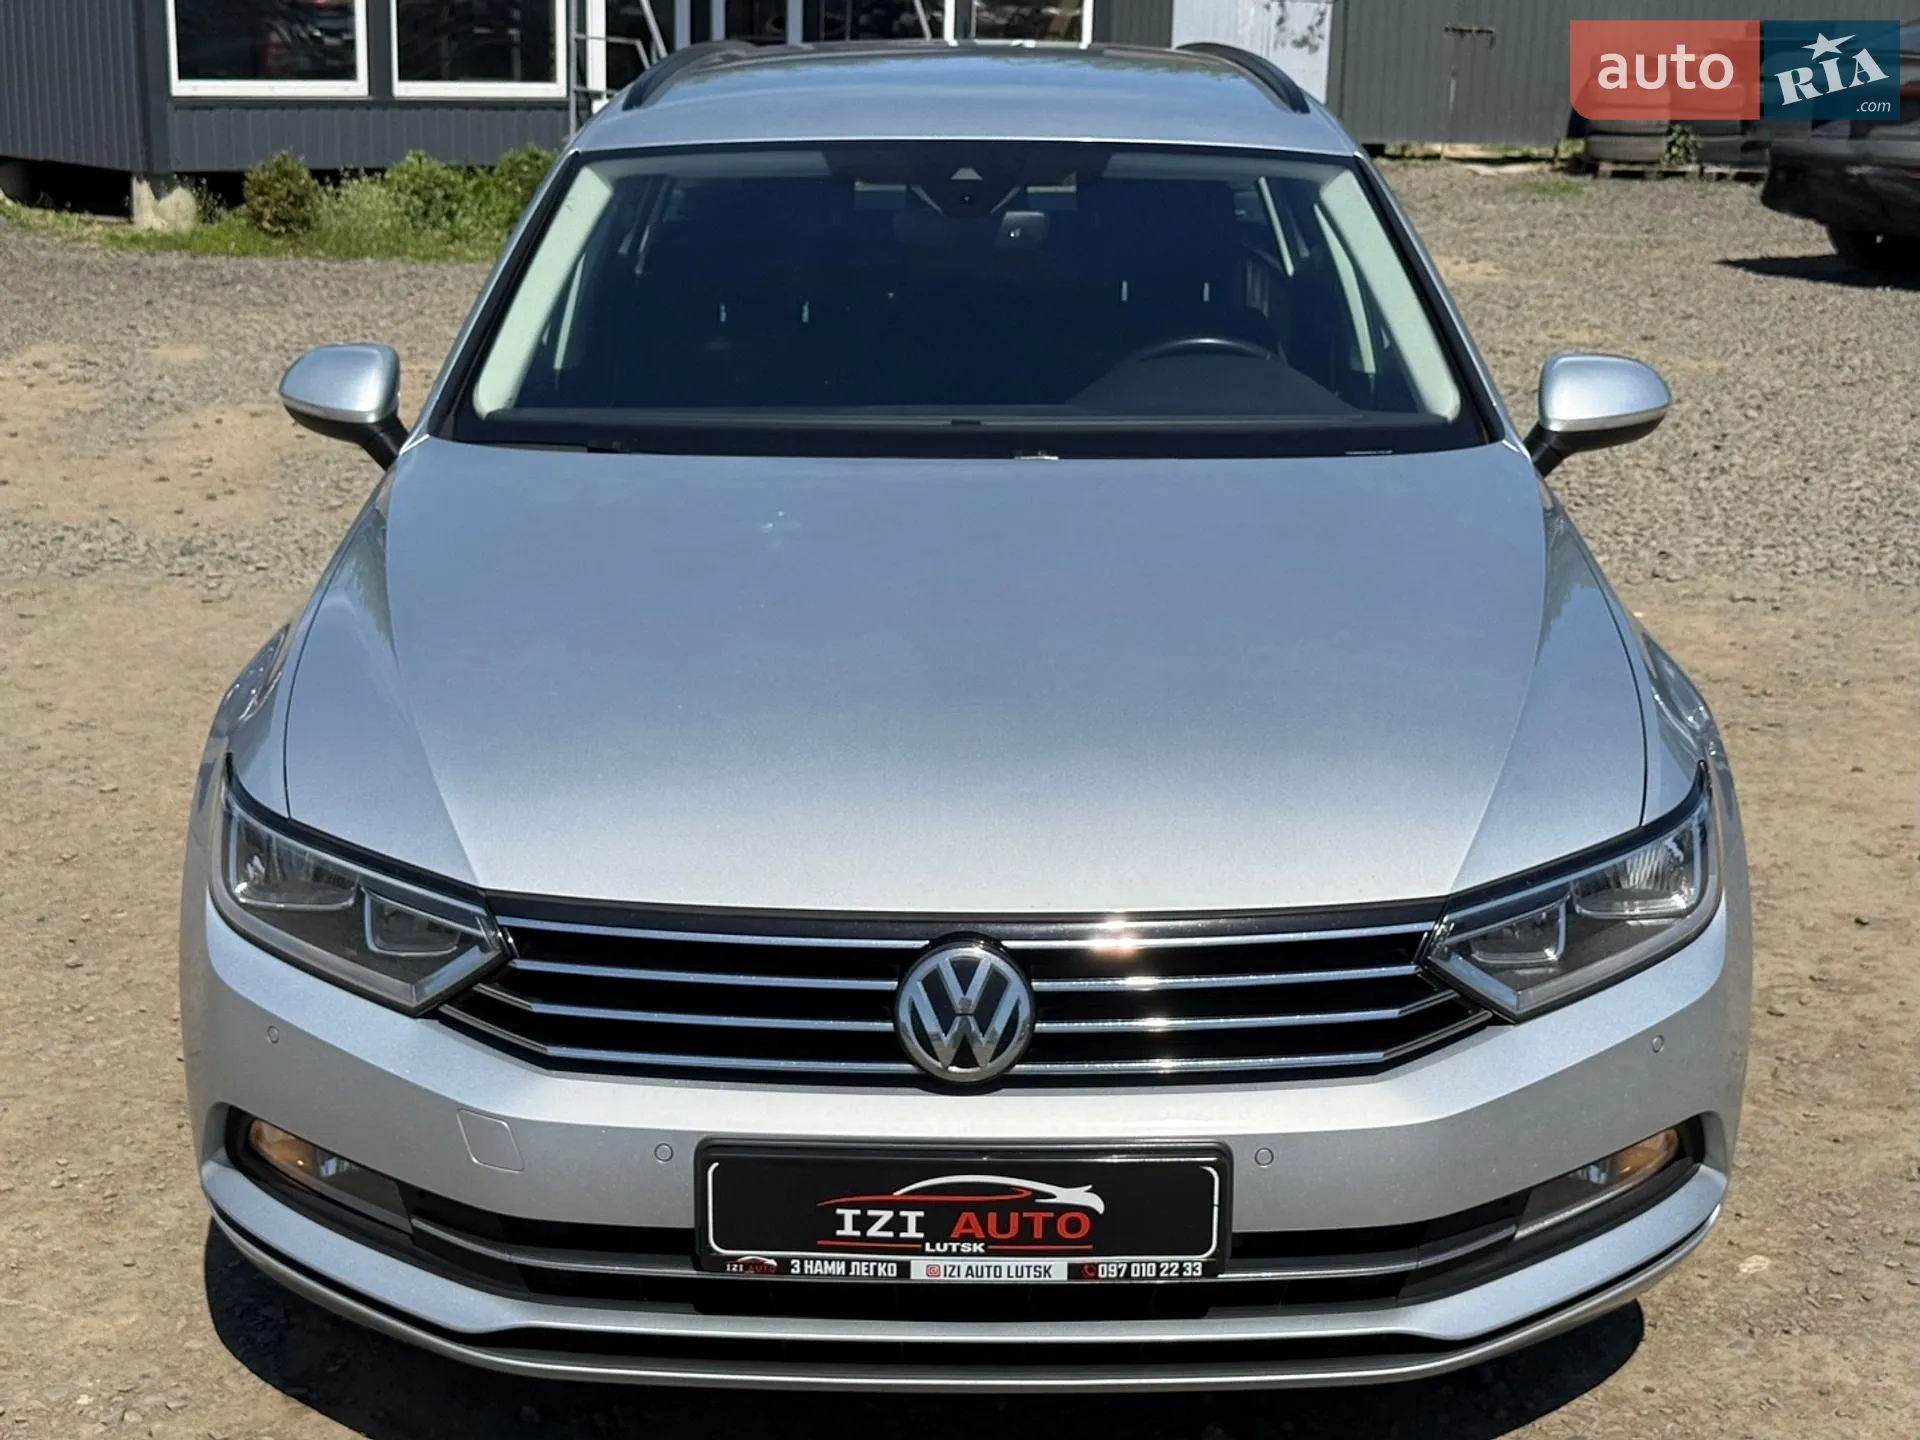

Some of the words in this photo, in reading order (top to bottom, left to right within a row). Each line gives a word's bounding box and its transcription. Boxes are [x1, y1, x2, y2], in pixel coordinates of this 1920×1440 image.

[835, 1208, 925, 1239] IZI
[950, 1211, 1092, 1240] AUTO
[924, 1242, 985, 1253] LUTSK
[803, 1259, 846, 1276] НАМИ
[849, 1261, 898, 1277] ЛЕГКО
[943, 1264, 961, 1278] IZI
[965, 1264, 1003, 1279] AUTO
[1006, 1264, 1053, 1279] LUTSK
[1098, 1262, 1127, 1278] 097
[1131, 1262, 1157, 1278] 010
[1159, 1262, 1180, 1277] 22
[1182, 1261, 1203, 1277] 33
